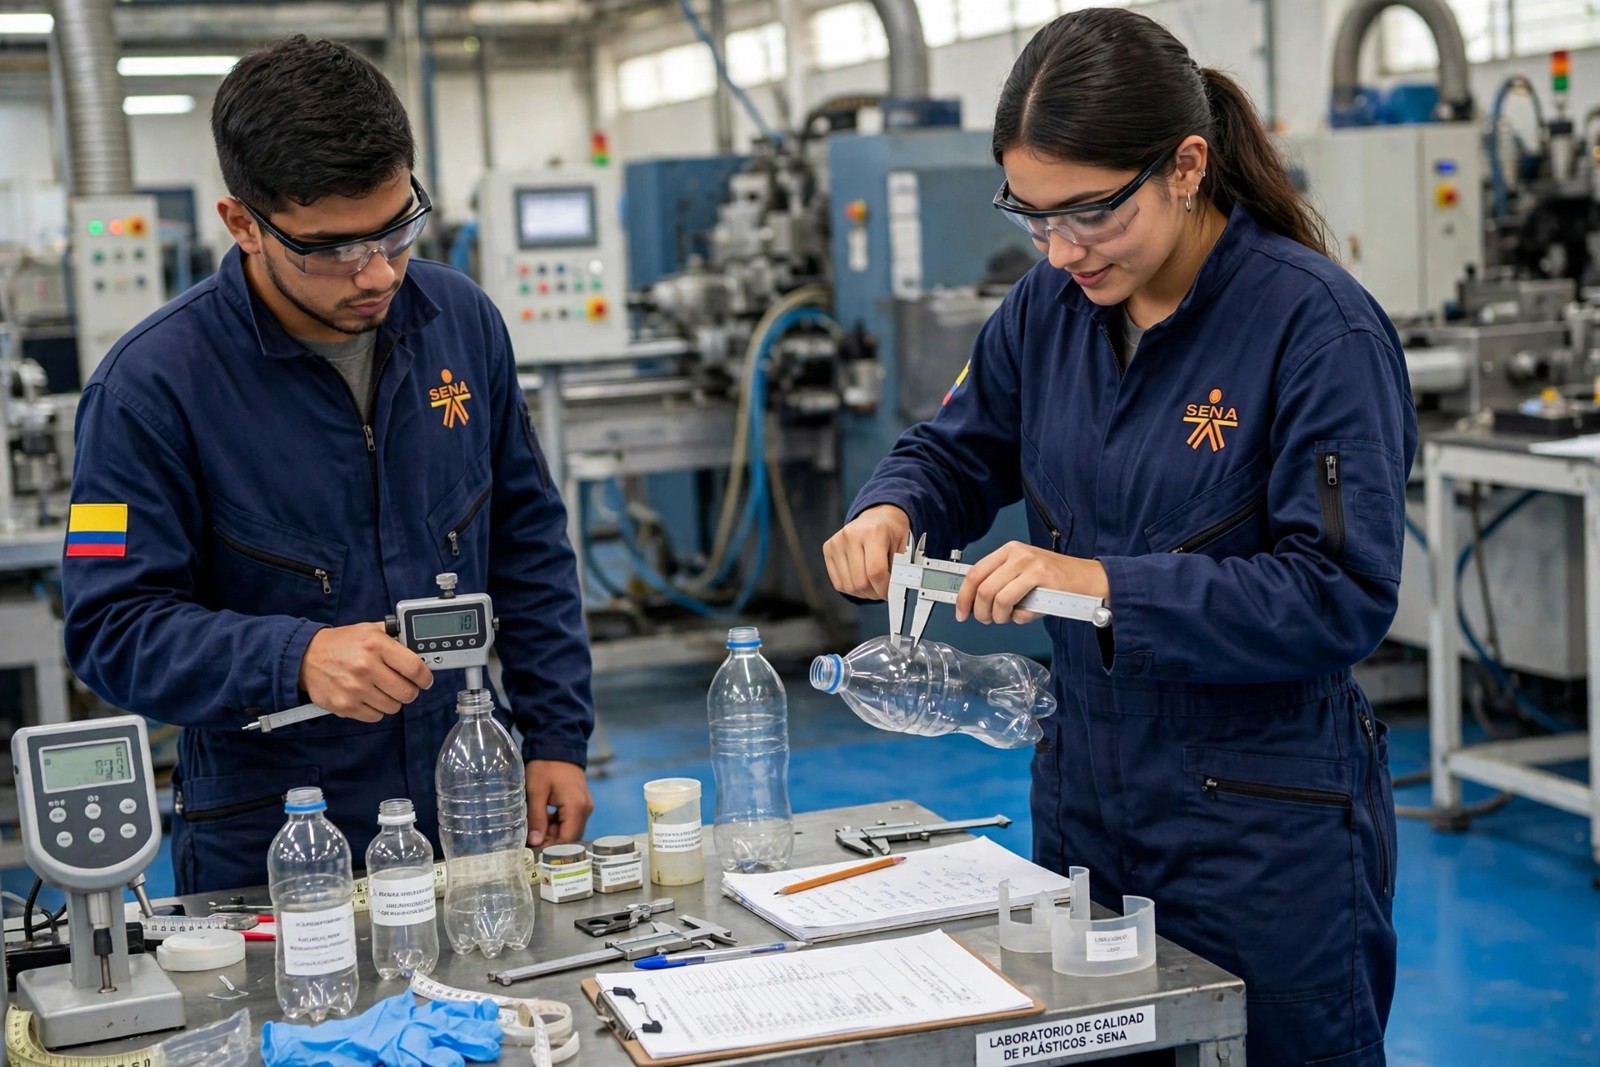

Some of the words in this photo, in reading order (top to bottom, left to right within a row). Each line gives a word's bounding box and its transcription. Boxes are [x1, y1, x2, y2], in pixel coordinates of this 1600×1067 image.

[429, 381, 469, 401] SENA
[1186, 404, 1238, 421] SENA
[990, 1025, 1073, 1049] LABORATORIO
[1076, 1022, 1092, 1034] DE
[1094, 1013, 1145, 1032] CALIDAD
[1004, 1048, 1020, 1061] DE
[1023, 1037, 1087, 1058] PLÁSTICOS
[1096, 1030, 1128, 1045] SENA
